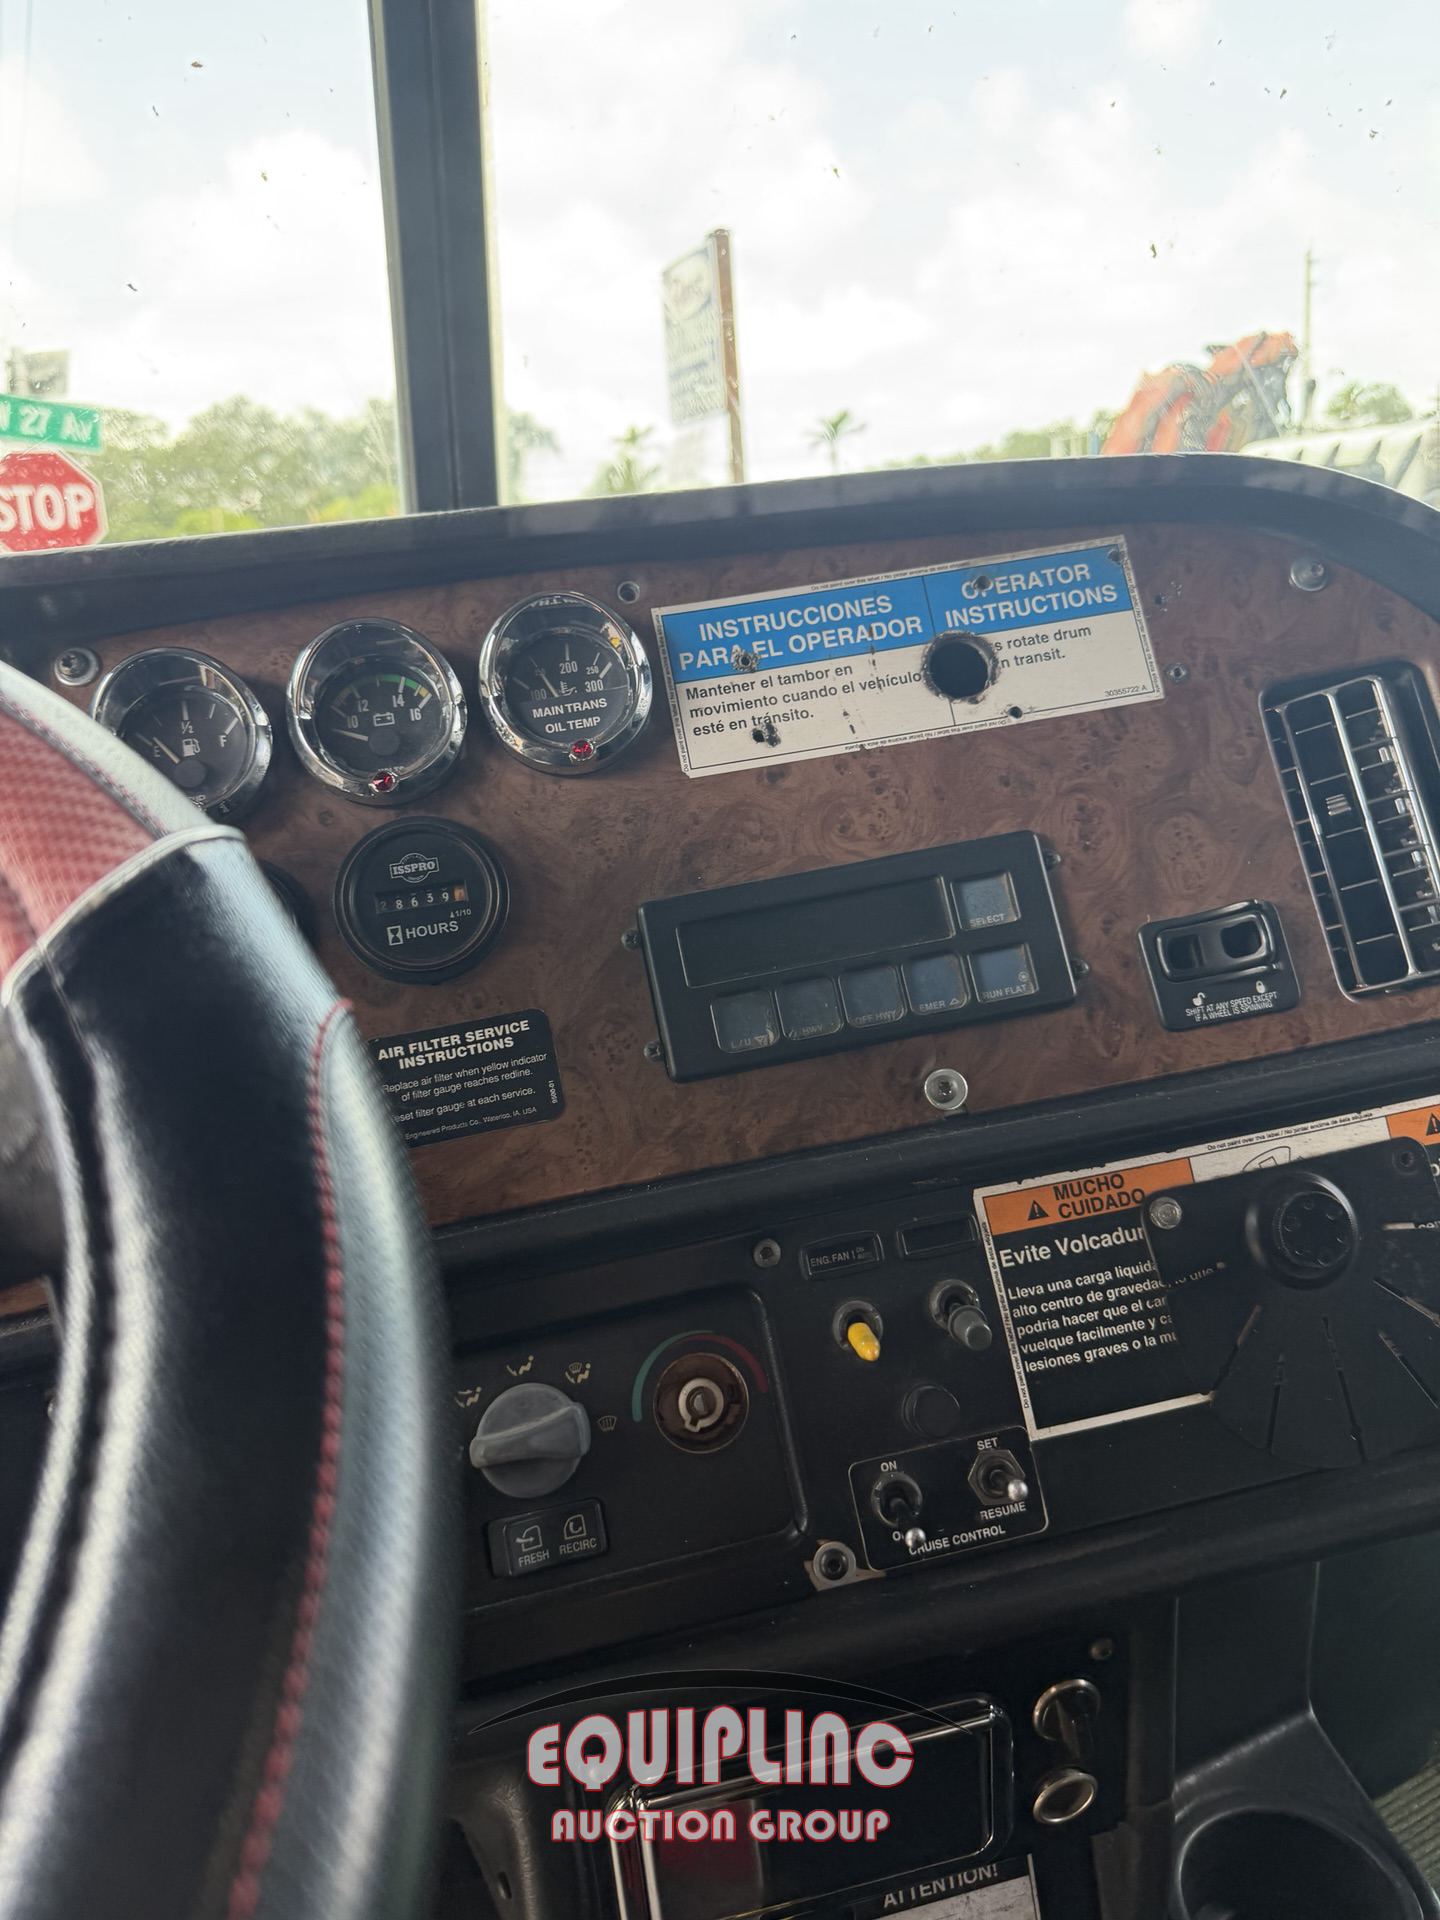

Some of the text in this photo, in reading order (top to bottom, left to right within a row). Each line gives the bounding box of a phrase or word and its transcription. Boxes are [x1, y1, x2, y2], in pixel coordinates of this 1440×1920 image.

[19, 404, 50, 436] 27
[0, 483, 94, 532] STOP
[962, 564, 1090, 599] OPERATOR
[700, 596, 892, 641] INSTRUCCIONES
[946, 585, 1117, 627] INSTRUCTIONS
[680, 617, 922, 670] PARA EL OPERADOR
[1007, 634, 1049, 649] rotate
[1054, 627, 1091, 641] drum
[559, 661, 578, 675] 200
[586, 665, 599, 676] 250
[1014, 649, 1065, 666] transit.
[585, 680, 604, 693] 300
[686, 666, 852, 700] Mantener el tambor en
[689, 668, 925, 718] movimiento cuando el vehículo
[357, 694, 405, 713] 12 14
[532, 698, 608, 719] MAIN TRANS
[348, 708, 422, 729] 10 16
[545, 716, 601, 734] OIL TEMP
[693, 709, 813, 736] esté en tránsito.
[154, 735, 227, 758] E F
[393, 861, 435, 875] ISSPRO
[455, 909, 471, 917] 1/10
[970, 914, 1006, 927] SELECT
[406, 921, 459, 940] HOURS
[982, 983, 1028, 1000] RUN FLAT
[1186, 1007, 1205, 1017] SHIFT
[1215, 1001, 1229, 1011] ANY
[1230, 997, 1252, 1008] SPEED
[1253, 991, 1278, 1003] EXCEPT
[919, 1000, 946, 1012] EMER
[1195, 1013, 1201, 1022] IF
[1209, 1008, 1232, 1020] WHEEL
[1241, 1000, 1273, 1014] SPINNING
[379, 1020, 529, 1060] AIR FILTER SERVICE
[399, 1037, 514, 1069] INSTRUCTIONS
[382, 1054, 547, 1094] Replace air filter when yellow indicator
[402, 1069, 533, 1101] of filter gauge reaches redline.
[394, 1088, 535, 1124] eset filter gauge at each service.
[1053, 1174, 1124, 1200] MUCHO
[1058, 1189, 1146, 1218] CUIDADO
[1000, 1245, 1051, 1267] Evite
[1055, 1227, 1143, 1255] Volcadur
[1008, 1285, 1044, 1299] Lleva
[1047, 1280, 1072, 1292] una
[1076, 1271, 1112, 1286] carga
[1013, 1305, 1037, 1317] alto
[1041, 1296, 1083, 1312] centro
[1087, 1287, 1103, 1301] de
[1017, 1298, 1164, 1339] podria hacer que el car
[1021, 1336, 1073, 1353] vuelque
[1076, 1320, 1145, 1342] facilmente
[1148, 1318, 1155, 1330] y
[1025, 1353, 1081, 1372] lesiones
[1084, 1343, 1129, 1362] graves
[1132, 1340, 1141, 1349] o
[1144, 1336, 1156, 1346] la
[976, 1437, 998, 1451] SET
[881, 1460, 898, 1472] ON
[980, 1501, 1026, 1520] RESUME
[952, 1525, 1006, 1545] CONTROL
[518, 1537, 597, 1567] FRESH RECIRC
[884, 1864, 997, 1908] ATTENTION!
